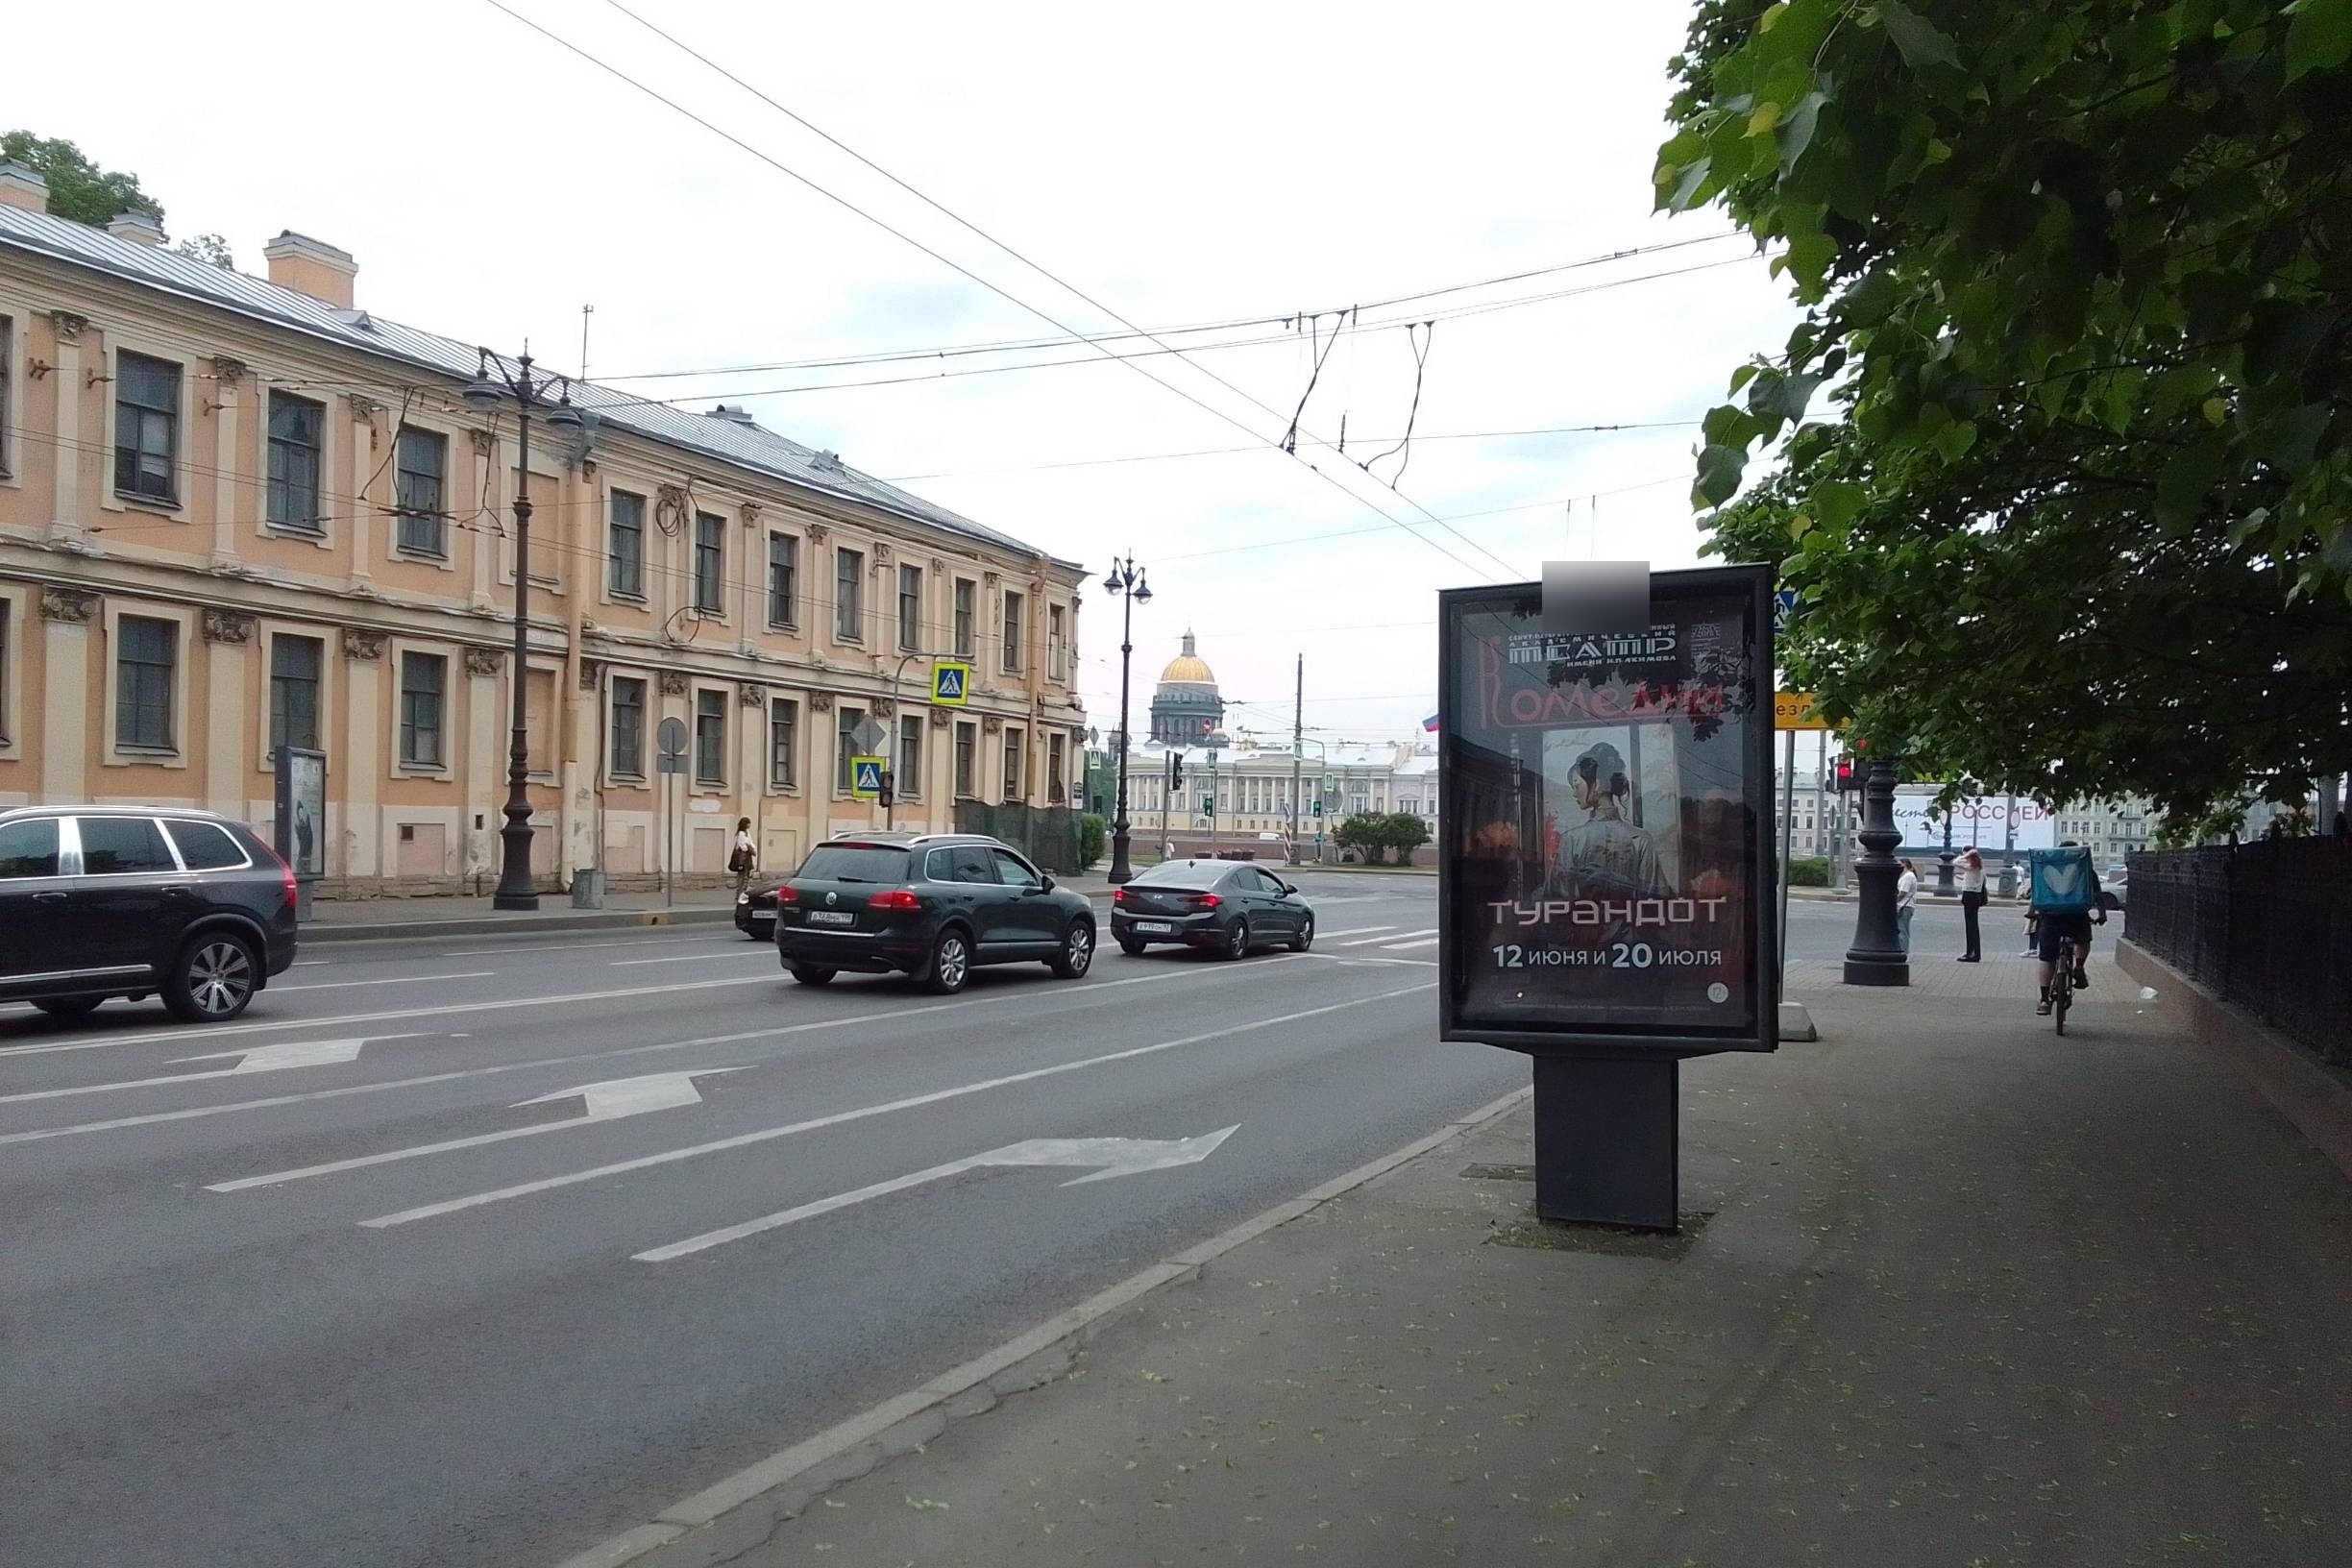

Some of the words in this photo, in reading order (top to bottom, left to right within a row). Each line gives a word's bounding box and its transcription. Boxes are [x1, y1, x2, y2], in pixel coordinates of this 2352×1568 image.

[1492, 944, 1524, 968] 12
[1529, 950, 1587, 966] июня
[1593, 950, 1606, 966] и
[1611, 943, 1654, 968] 20
[1658, 950, 1723, 967] июля
